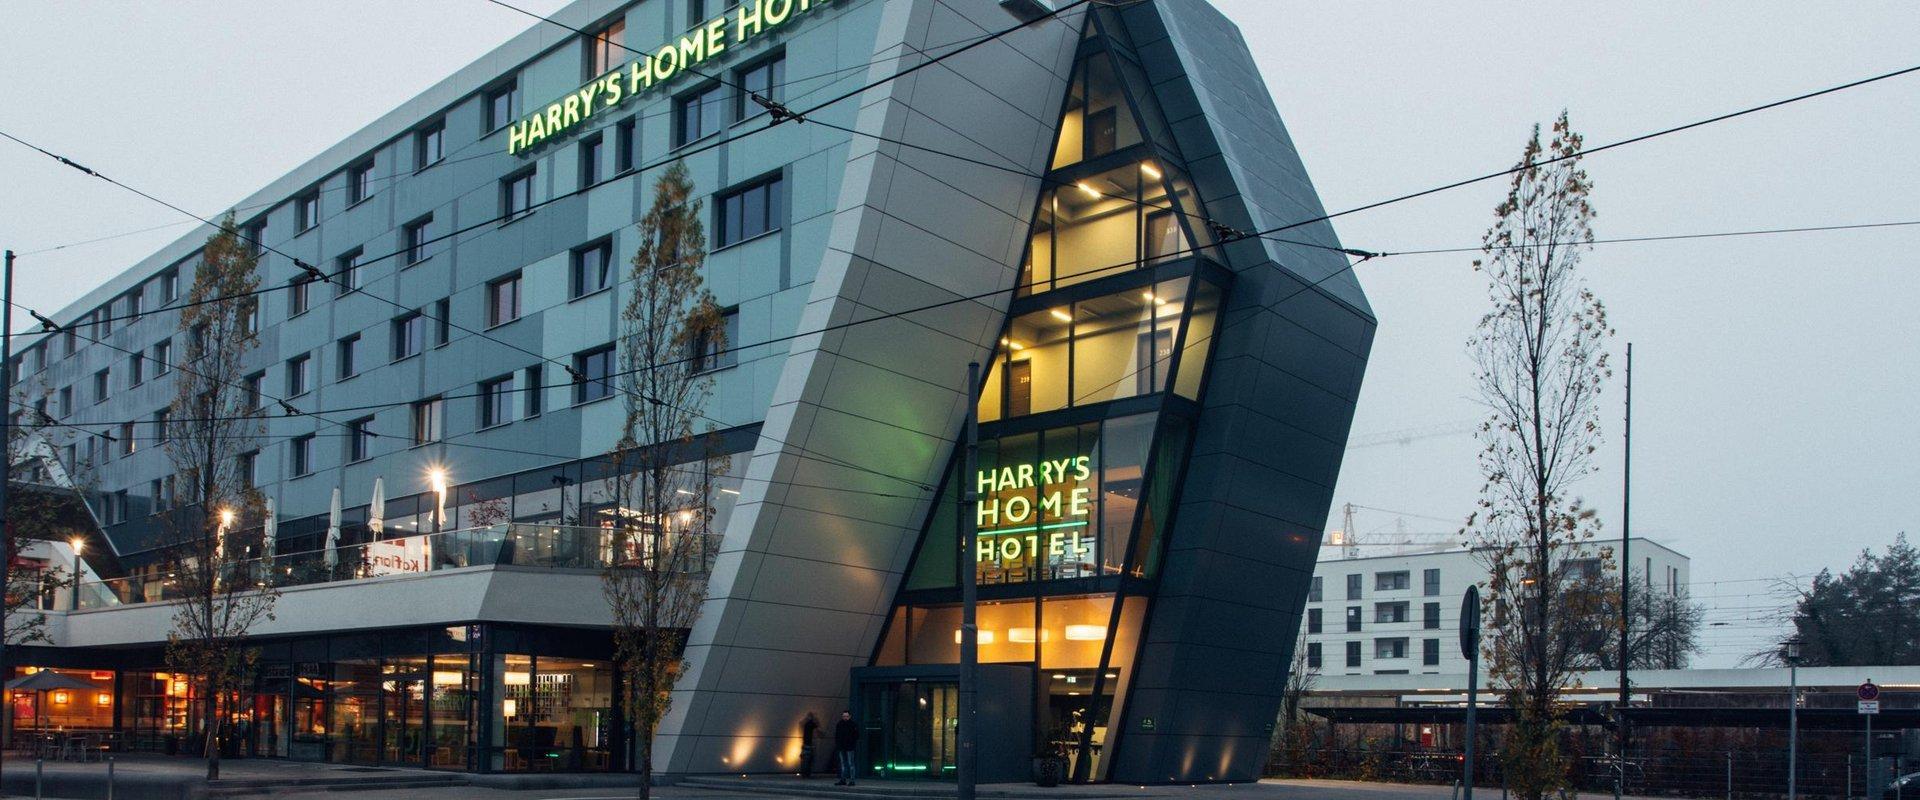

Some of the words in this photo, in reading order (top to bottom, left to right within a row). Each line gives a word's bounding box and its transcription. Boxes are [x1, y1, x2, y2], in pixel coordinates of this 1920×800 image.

[509, 72, 624, 156] HARRY'S
[632, 17, 727, 95] HOME
[977, 456, 1090, 494] HARRY'S
[977, 487, 1089, 526] HOME
[976, 531, 1088, 562] HOTEL
